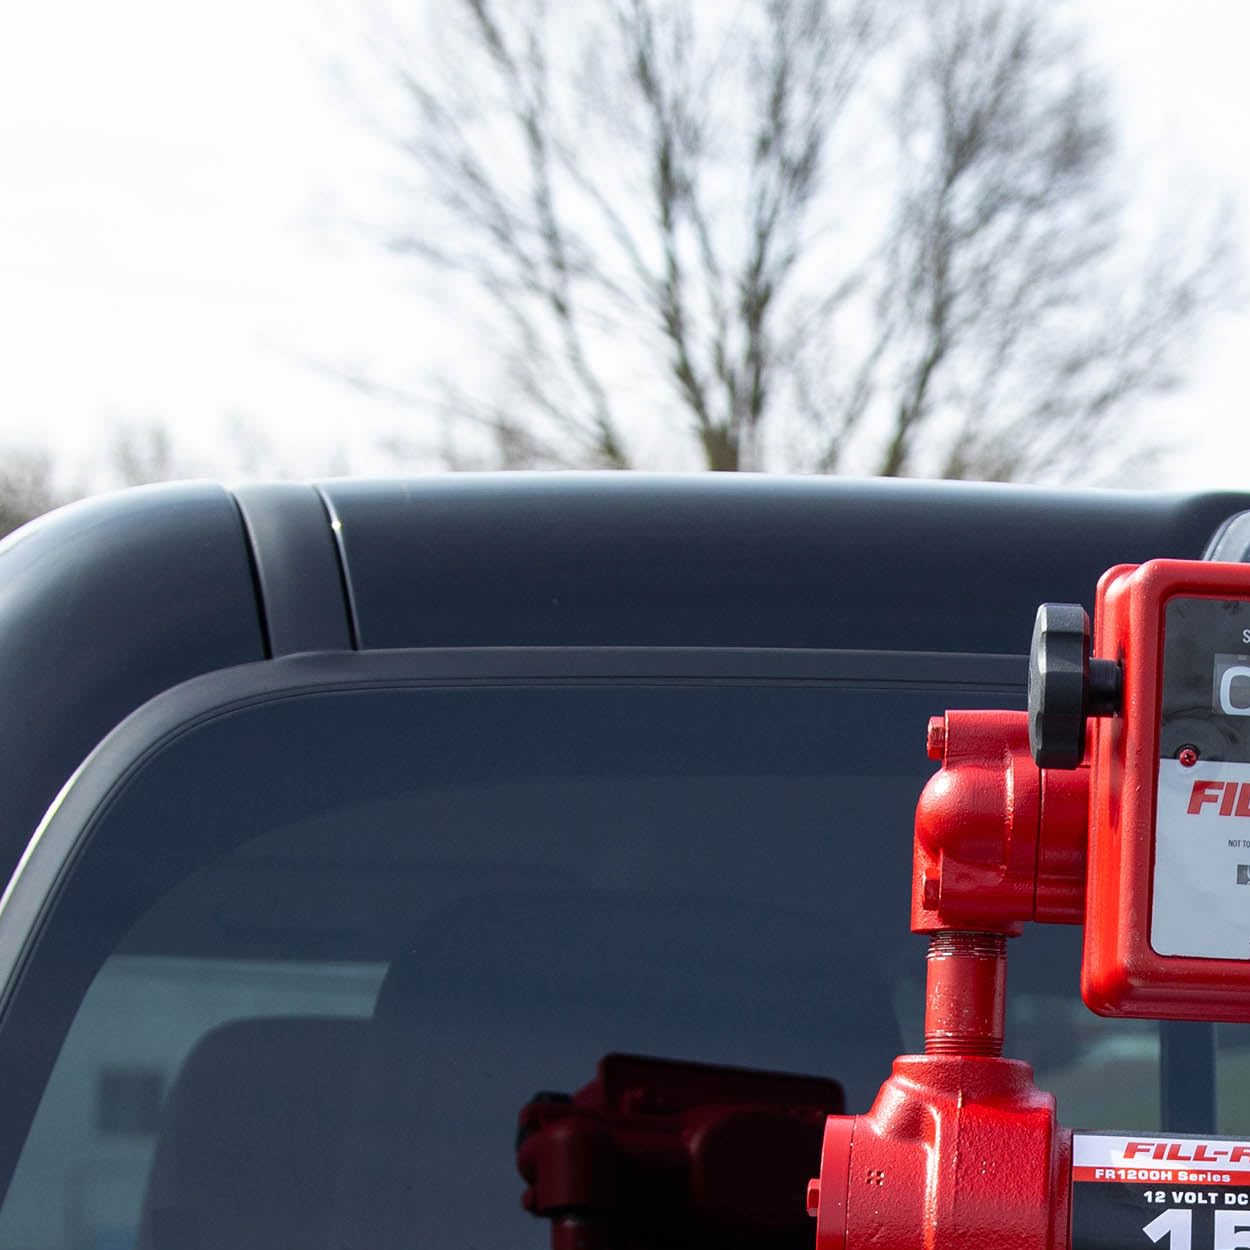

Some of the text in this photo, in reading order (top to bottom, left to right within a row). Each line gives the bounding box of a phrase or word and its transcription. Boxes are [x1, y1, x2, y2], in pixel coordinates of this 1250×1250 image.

[1227, 839, 1242, 848] NOT
[1243, 840, 1250, 848] TO
[1095, 1168, 1231, 1182] FR1200H Series
[1143, 1190, 1166, 1203] 12
[1172, 1191, 1218, 1204] VOLT
[1224, 1193, 1249, 1205] DC
